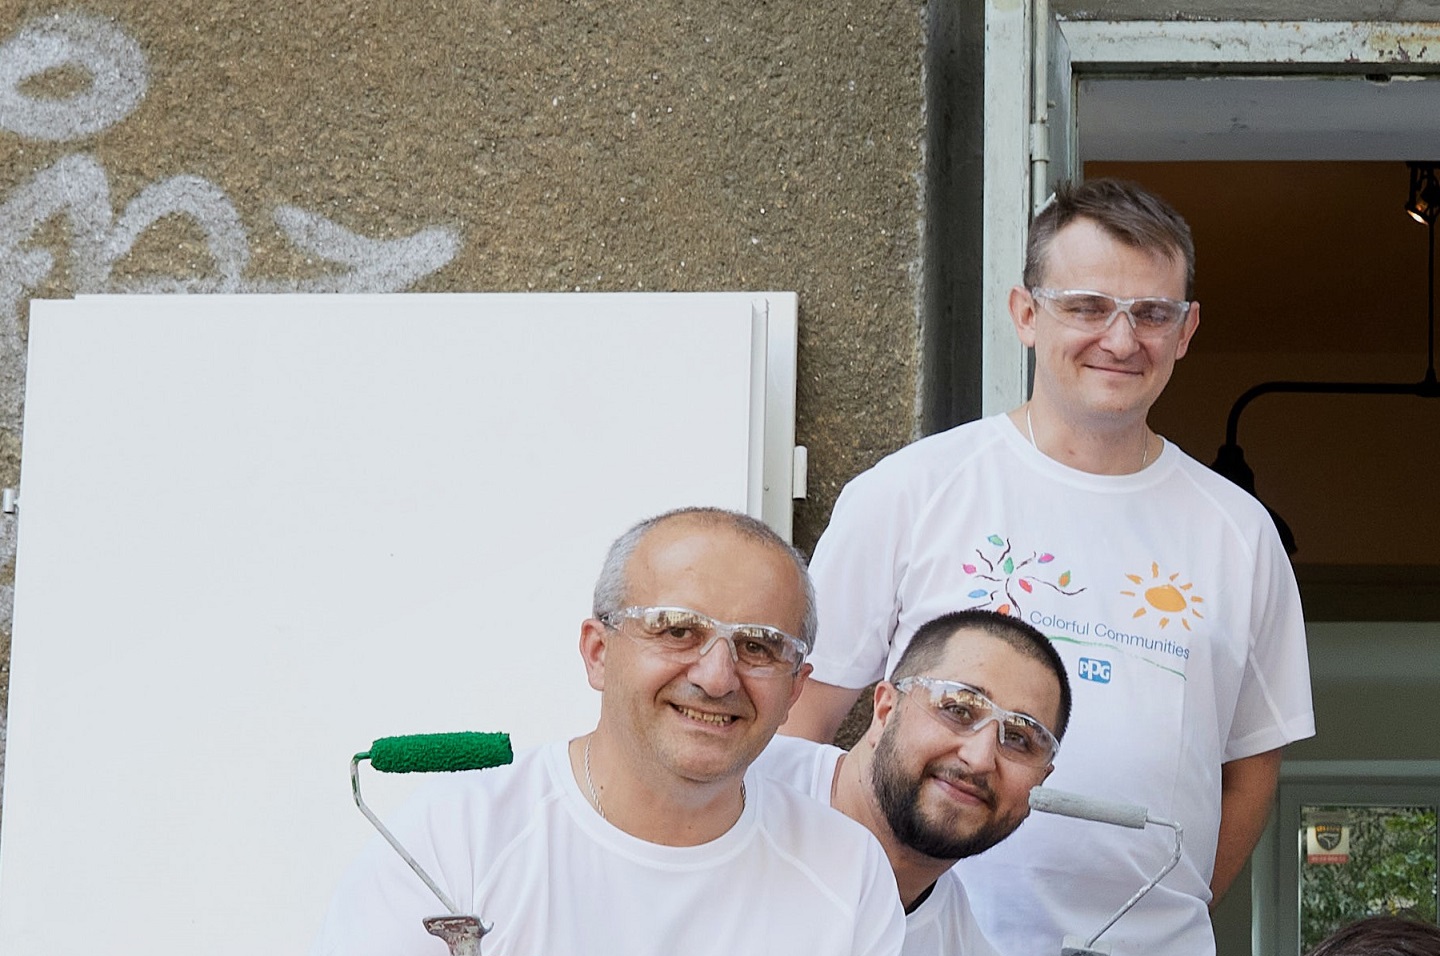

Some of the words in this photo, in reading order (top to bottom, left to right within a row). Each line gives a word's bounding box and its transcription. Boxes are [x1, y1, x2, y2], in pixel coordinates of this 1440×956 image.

[1030, 611, 1089, 636] Colorful
[1094, 623, 1190, 659] Communities
[1079, 657, 1111, 683] PPG
